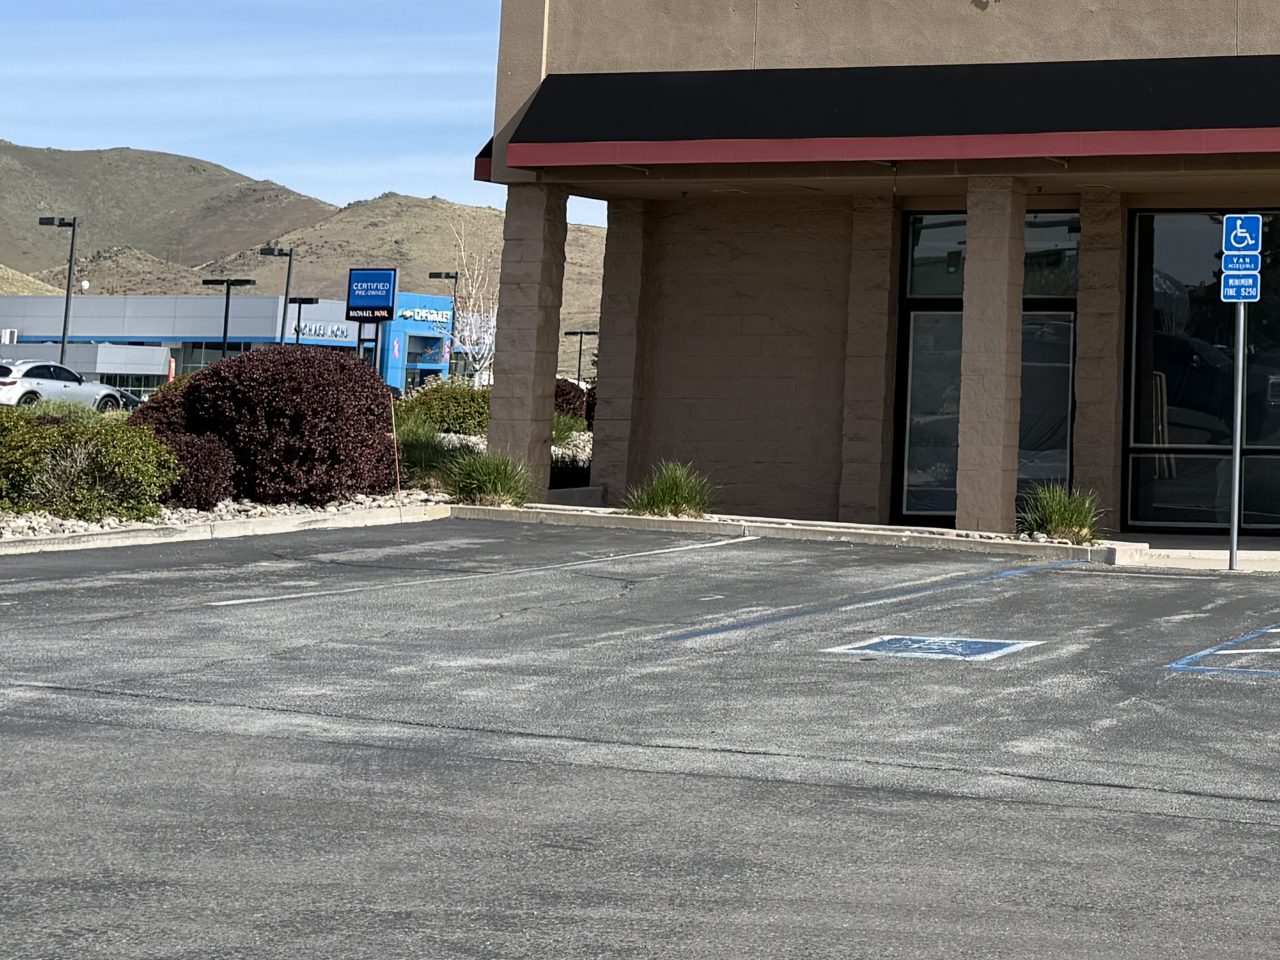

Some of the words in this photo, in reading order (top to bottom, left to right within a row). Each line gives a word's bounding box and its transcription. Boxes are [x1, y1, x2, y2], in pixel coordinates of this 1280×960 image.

[353, 282, 390, 290] CERTIFIED
[1224, 287, 1237, 296] FINE
[1240, 287, 1257, 296] $250
[292, 321, 326, 337] MCHAEL
